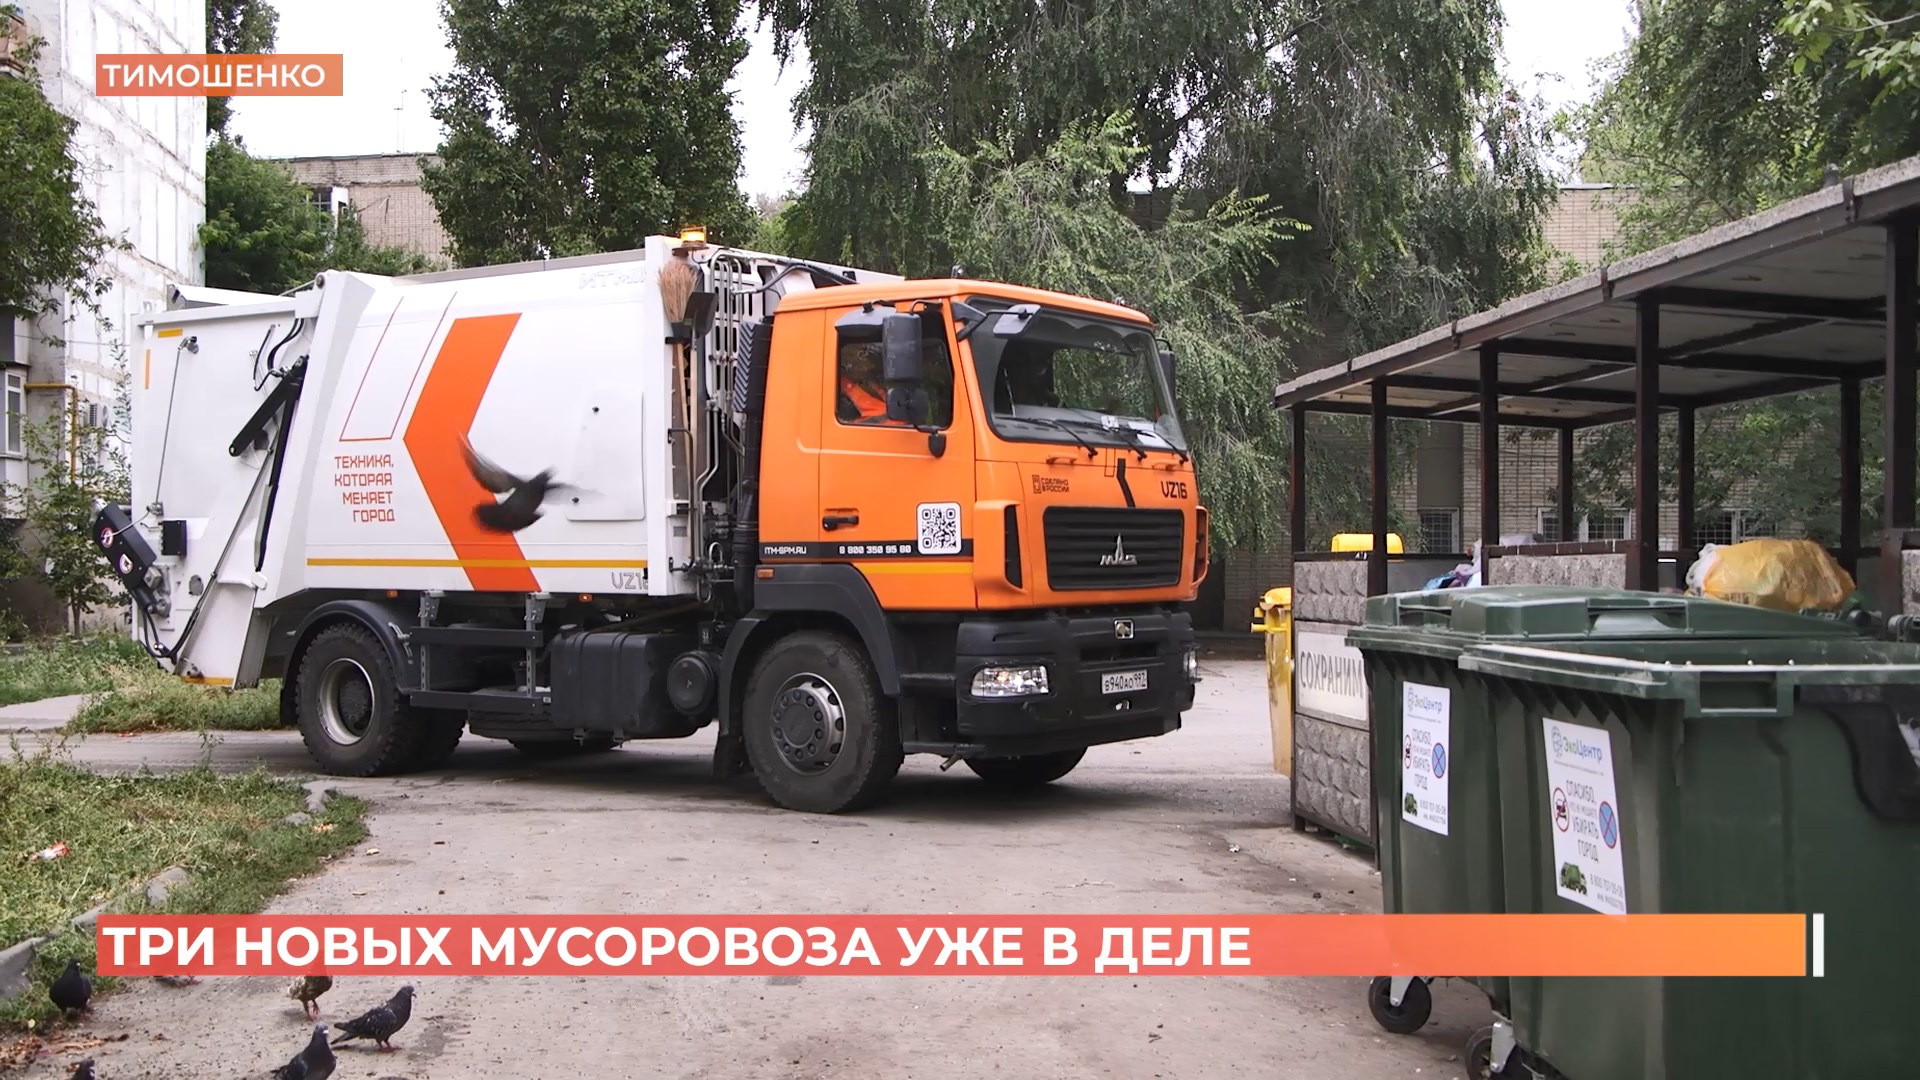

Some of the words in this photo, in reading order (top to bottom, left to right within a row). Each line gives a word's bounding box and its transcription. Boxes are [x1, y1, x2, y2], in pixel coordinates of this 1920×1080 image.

[334, 454, 394, 468] ТЕХНИКА,
[334, 473, 392, 486] КОТОРАЯ
[1160, 481, 1188, 499] VZ16
[342, 491, 393, 504] МЕНЯЕТ
[353, 509, 395, 522] ГОРОД
[839, 545, 846, 555] 8
[847, 545, 865, 555] 800
[1300, 651, 1363, 700] СОХРАНИМ
[1563, 736, 1603, 764] ЭкоЦентр
